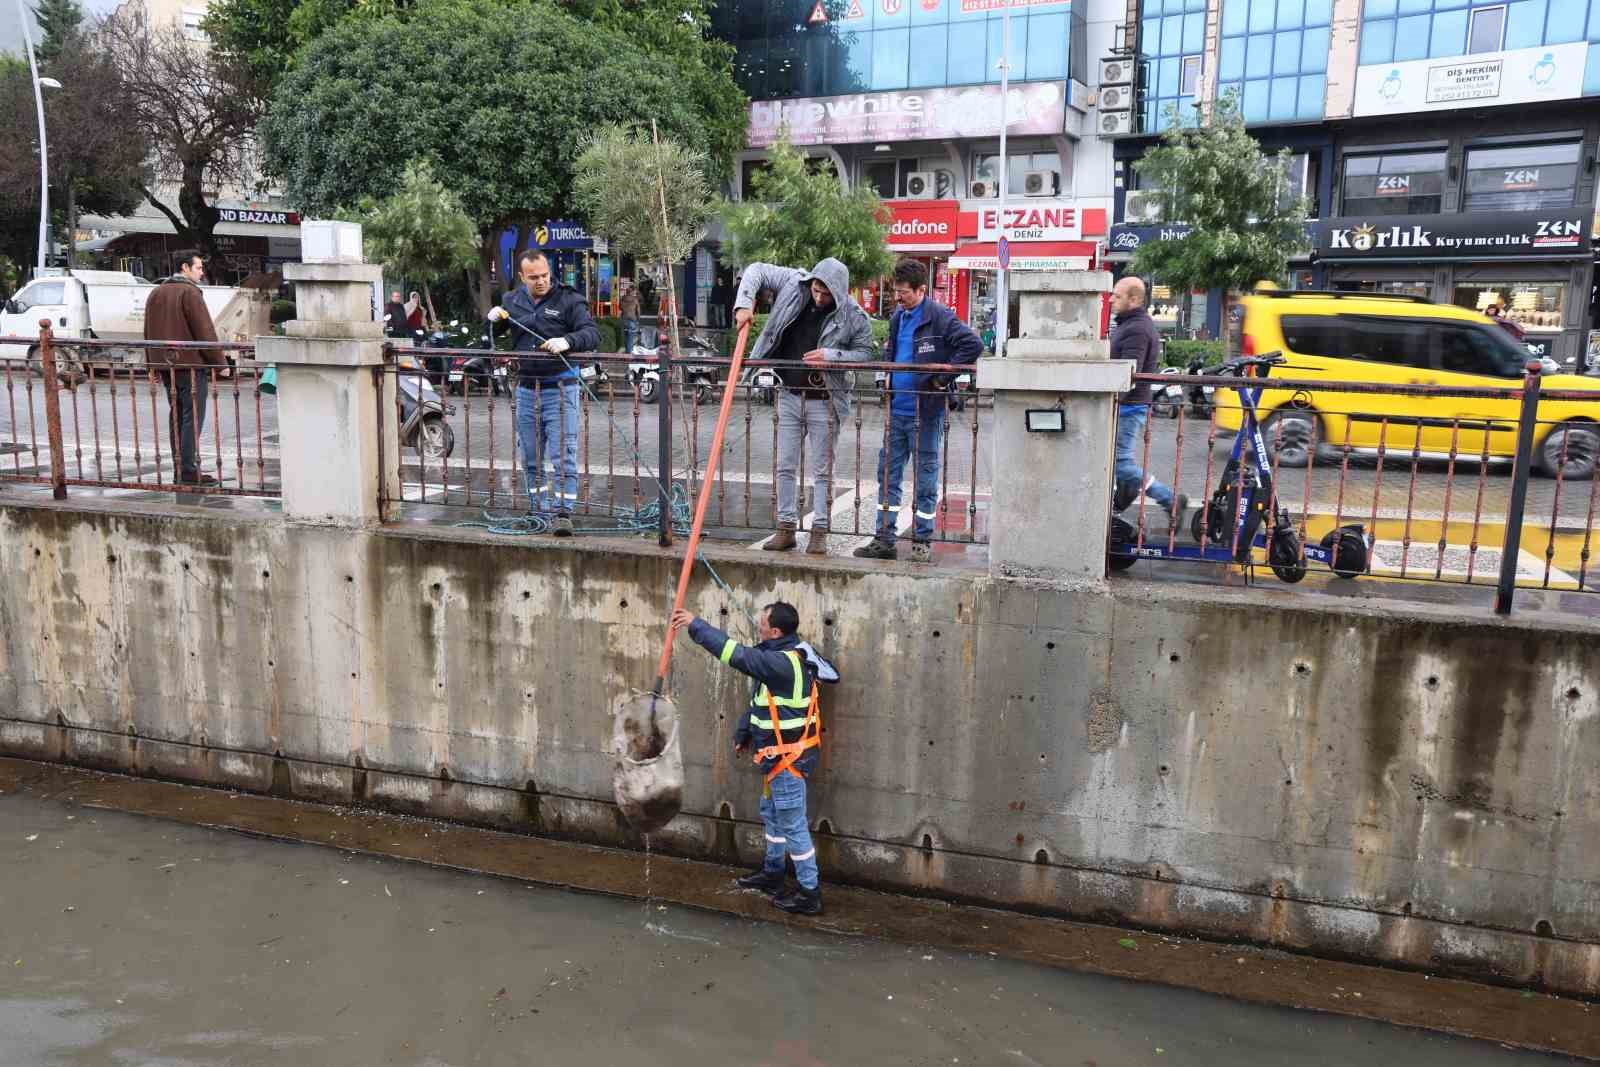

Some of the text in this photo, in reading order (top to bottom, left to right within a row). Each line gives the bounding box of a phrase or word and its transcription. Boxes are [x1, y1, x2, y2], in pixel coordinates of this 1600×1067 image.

[1378, 175, 1410, 189] ZEN
[1503, 169, 1540, 184] ZEN
[239, 211, 287, 224] BAZAAR
[983, 207, 1076, 230] ECZANE
[1013, 229, 1044, 239] DENİZ
[1535, 219, 1582, 236] ZEN
[1435, 233, 1532, 248] Kuyumculuk
